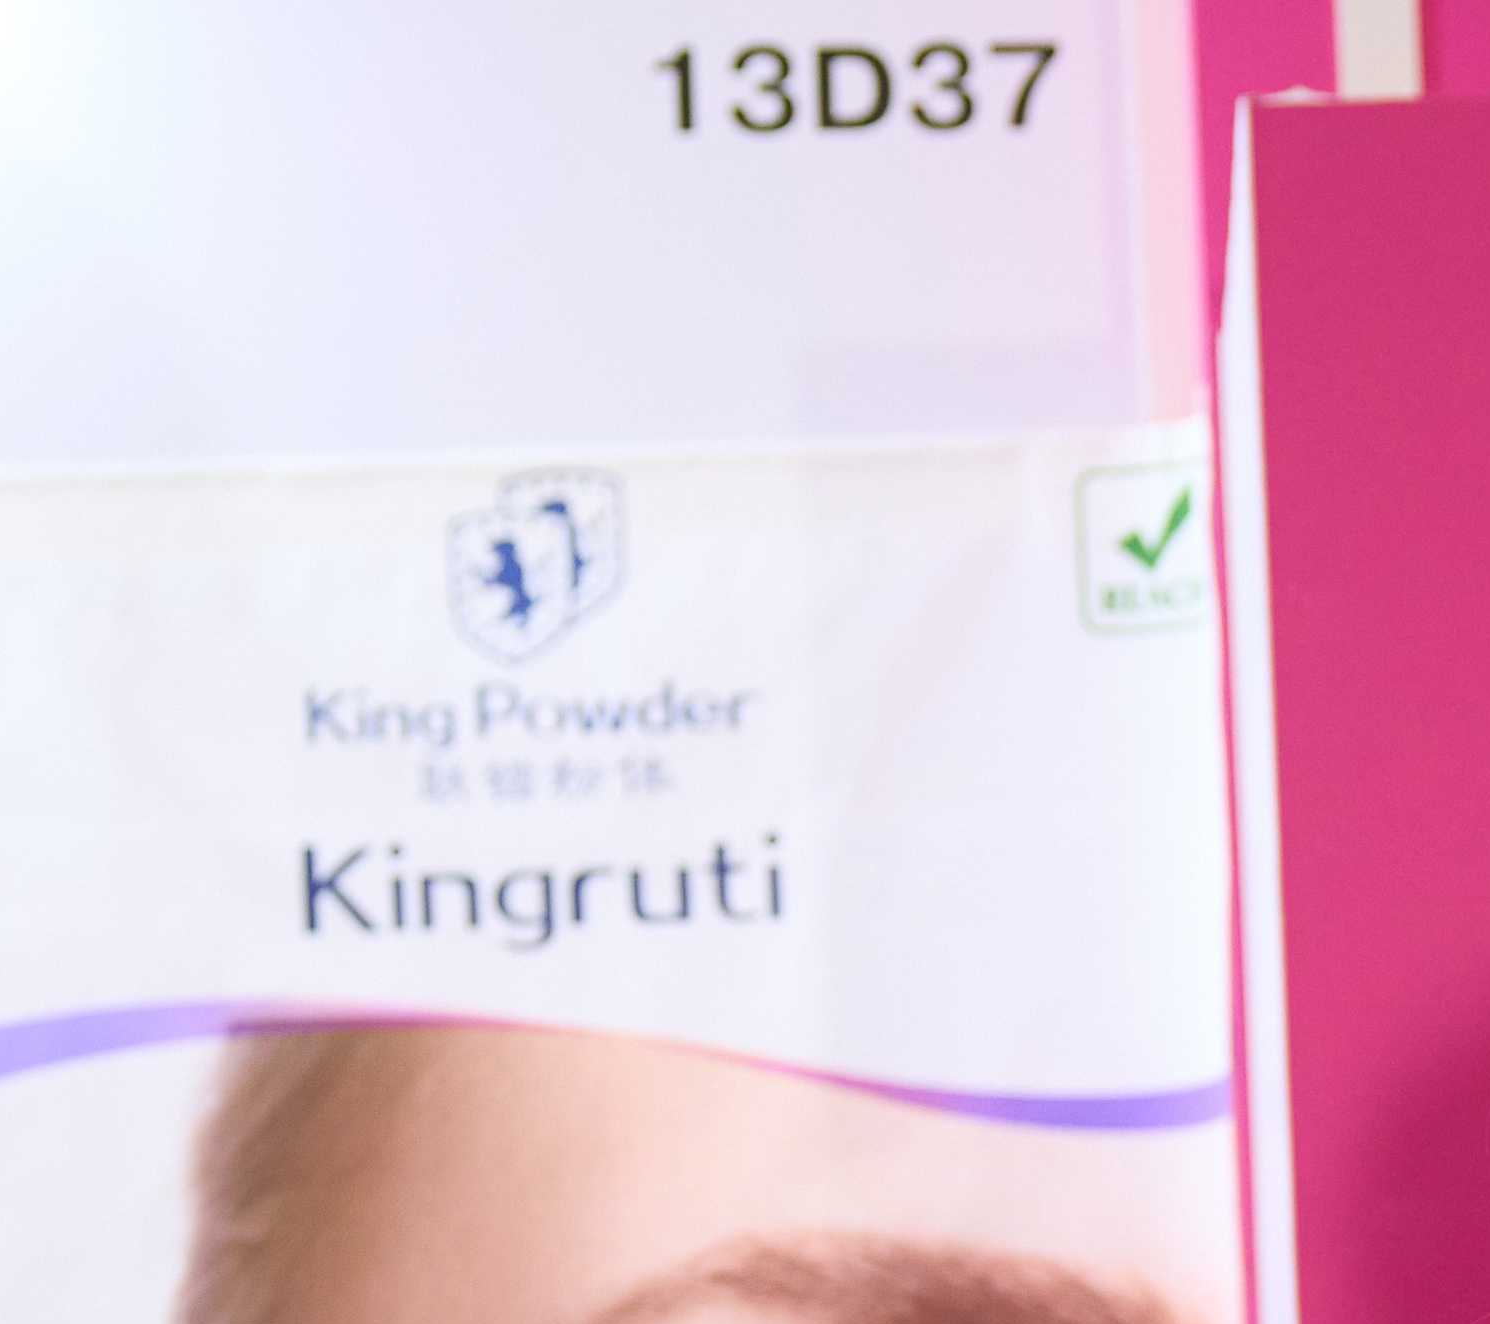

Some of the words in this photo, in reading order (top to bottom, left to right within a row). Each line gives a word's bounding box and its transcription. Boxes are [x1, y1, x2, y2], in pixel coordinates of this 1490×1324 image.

[657, 42, 1059, 134] 13D37
[301, 685, 457, 748] King
[474, 678, 760, 737] Powder
[299, 832, 786, 953] Kingruti
